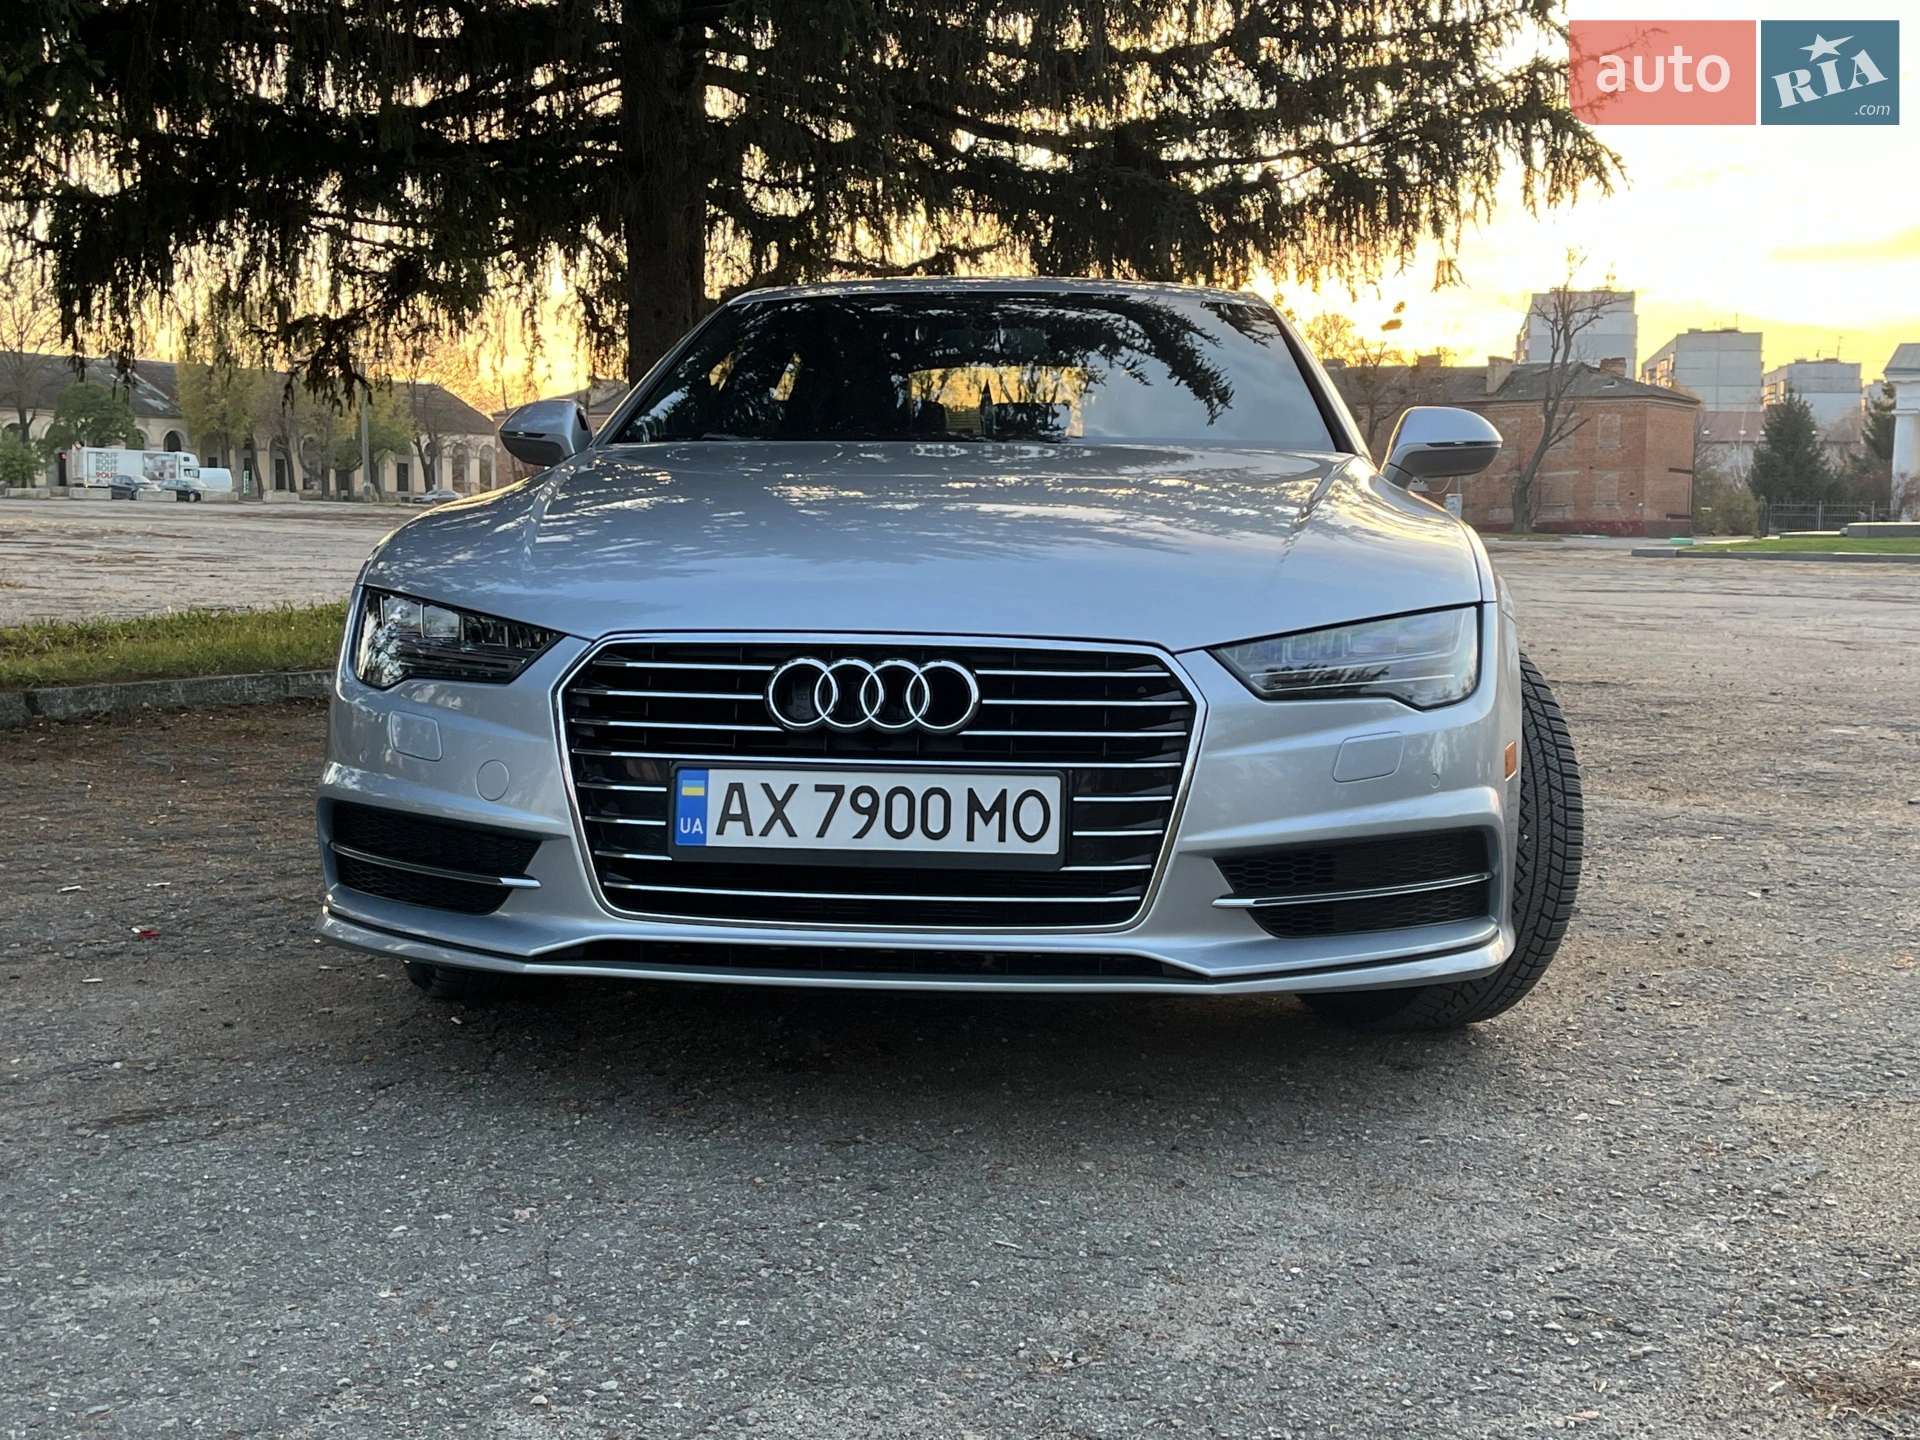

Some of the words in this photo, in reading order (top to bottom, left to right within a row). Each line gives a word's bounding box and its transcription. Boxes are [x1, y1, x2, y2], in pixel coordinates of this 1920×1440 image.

[680, 817, 703, 835] UA
[716, 782, 799, 838] AX
[814, 784, 952, 841] 7900
[966, 787, 1051, 844] MO
